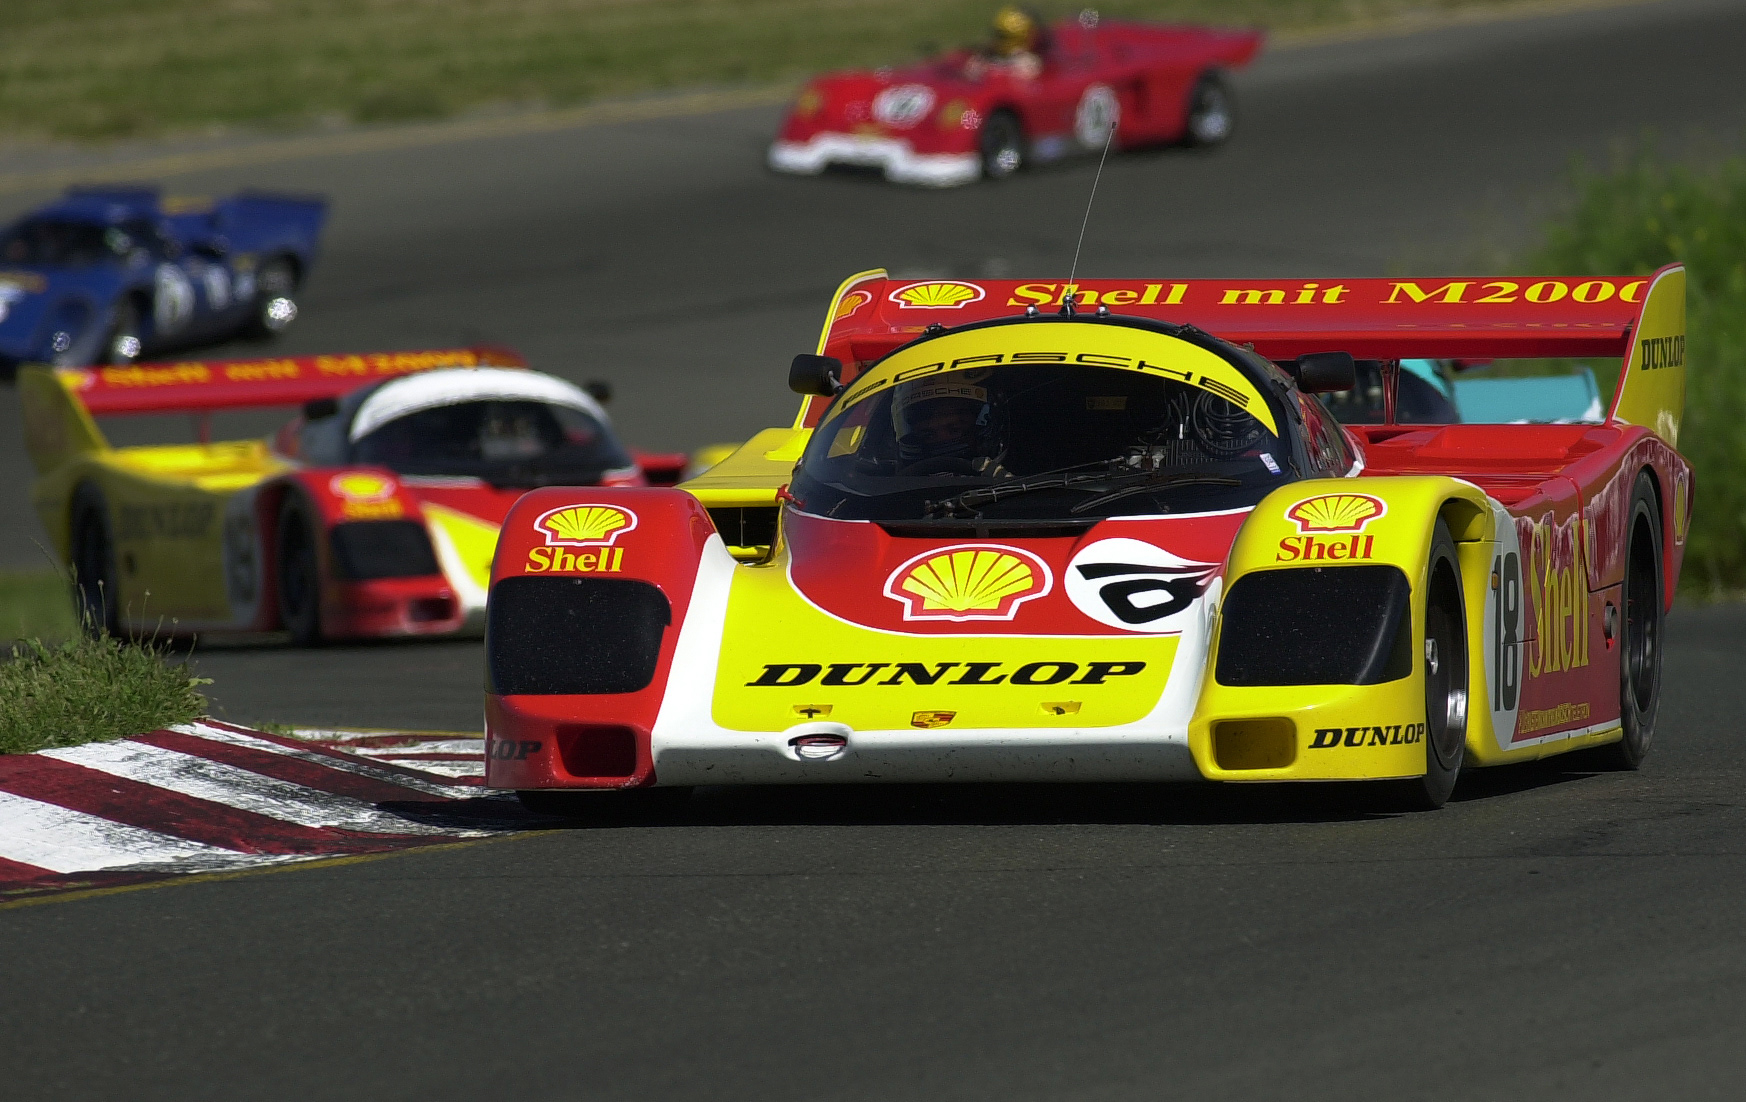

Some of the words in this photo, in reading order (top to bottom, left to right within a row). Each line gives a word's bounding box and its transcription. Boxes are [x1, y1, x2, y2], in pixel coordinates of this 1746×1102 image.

[1006, 282, 1189, 307] Shell
[1218, 283, 1350, 305] mit
[1640, 335, 1686, 371] DUNLOP
[840, 352, 1250, 408] PORSCHE
[525, 547, 624, 573] Shell
[1275, 535, 1374, 563] Shell
[1528, 518, 1590, 680] Shell
[1491, 551, 1518, 712] 18
[744, 662, 1147, 687] DUNLOP
[1307, 723, 1425, 749] DUNLOP
